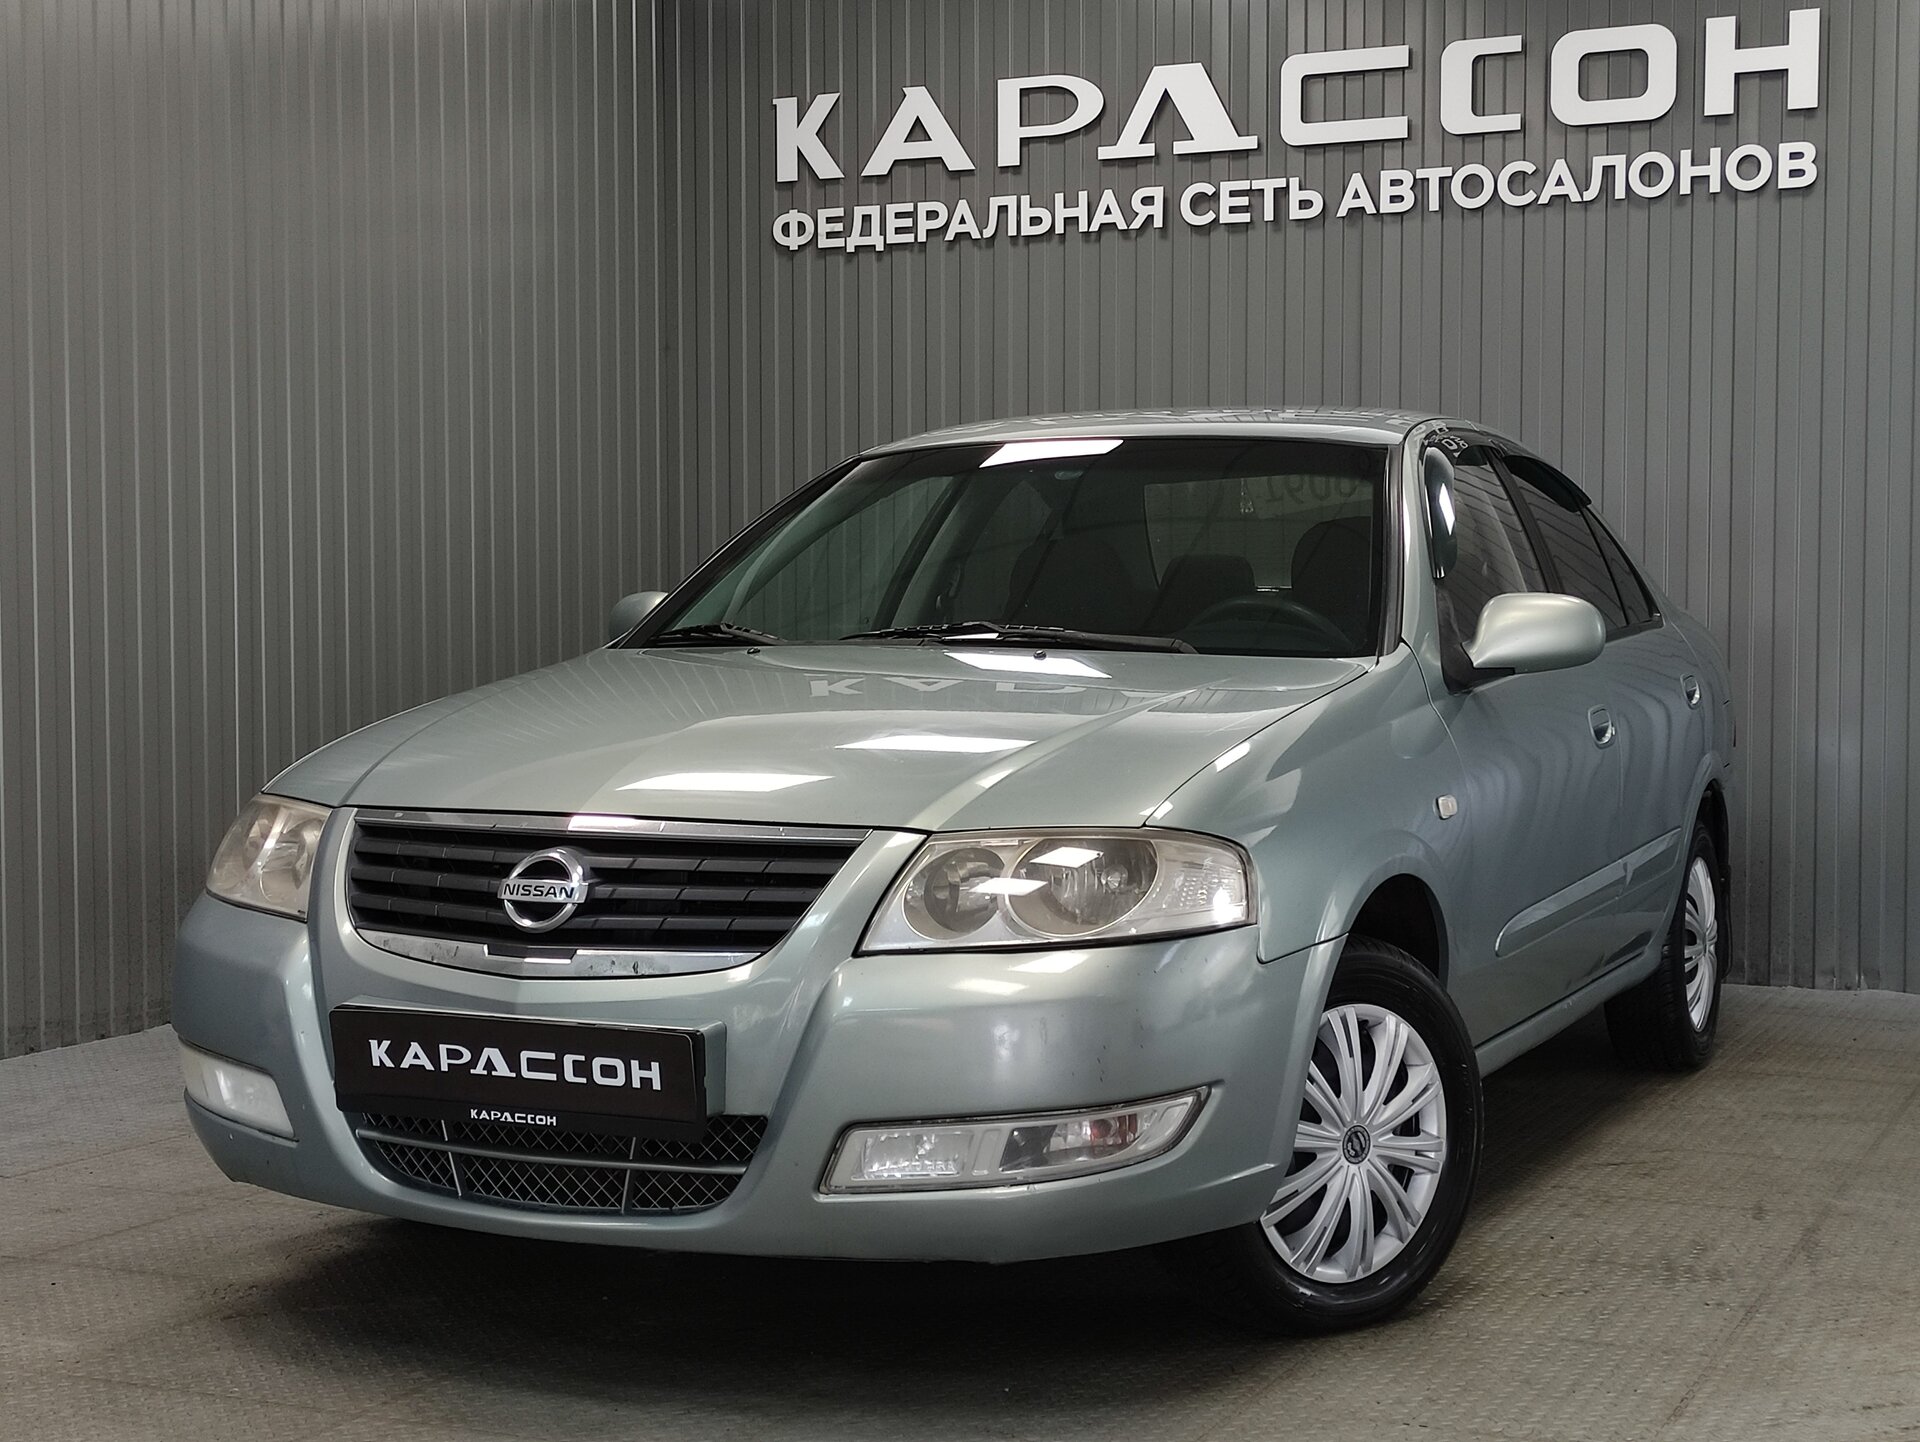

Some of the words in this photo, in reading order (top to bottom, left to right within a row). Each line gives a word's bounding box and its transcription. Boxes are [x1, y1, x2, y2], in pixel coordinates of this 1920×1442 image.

[772, 186, 1165, 253] ФЕДЕРАЛЬНАЯ
[1179, 176, 1324, 226] СЕТЬ
[1336, 141, 1819, 217] АВТОСАЛОНОВ
[503, 883, 575, 899] NISSAN
